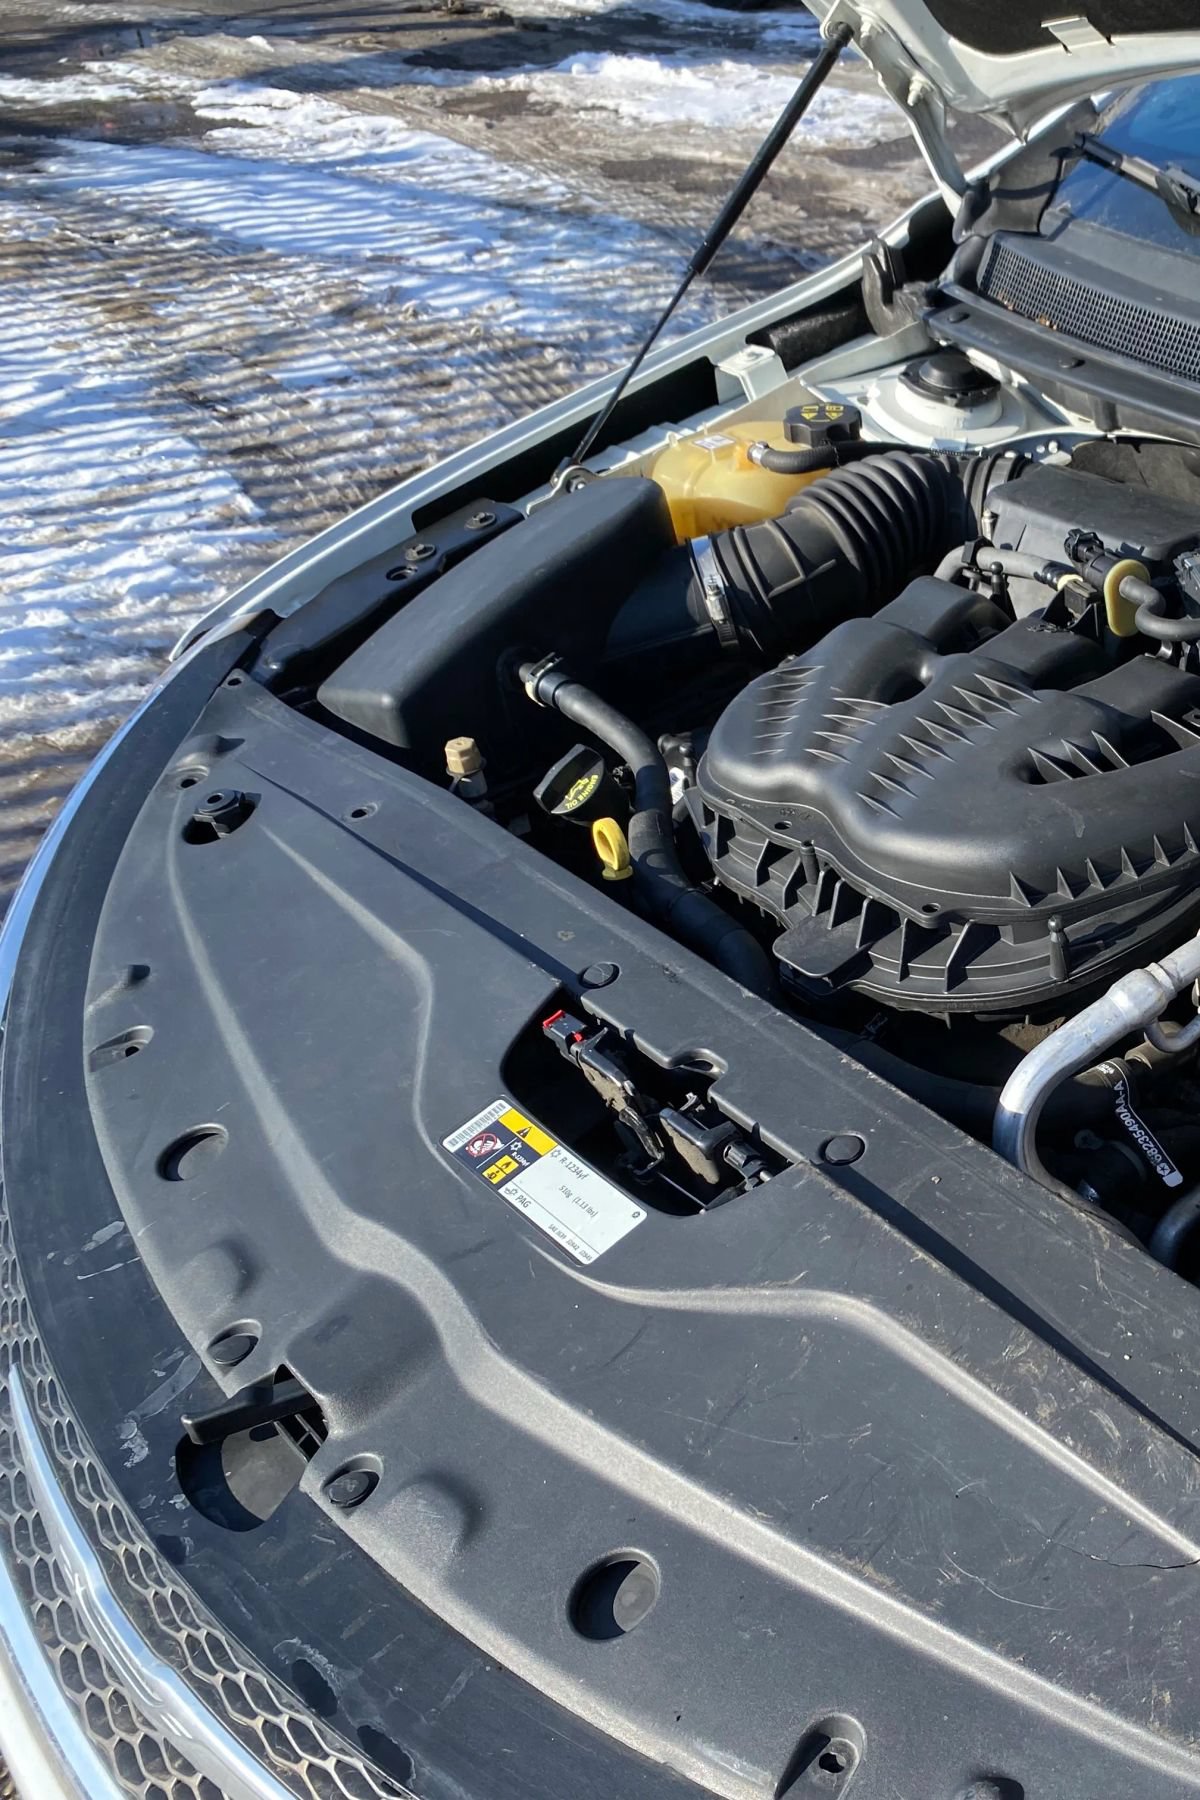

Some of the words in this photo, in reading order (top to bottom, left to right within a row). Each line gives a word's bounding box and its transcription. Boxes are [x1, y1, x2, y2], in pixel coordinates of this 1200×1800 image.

[577, 774, 599, 801] ENGINE
[565, 799, 578, 810] OIL
[558, 1157, 588, 1180] R-1234yf
[516, 1195, 531, 1207] PAG
[558, 1185, 573, 1197] 510g
[572, 1196, 588, 1209] (1.13
[586, 1207, 598, 1217] lbs)
